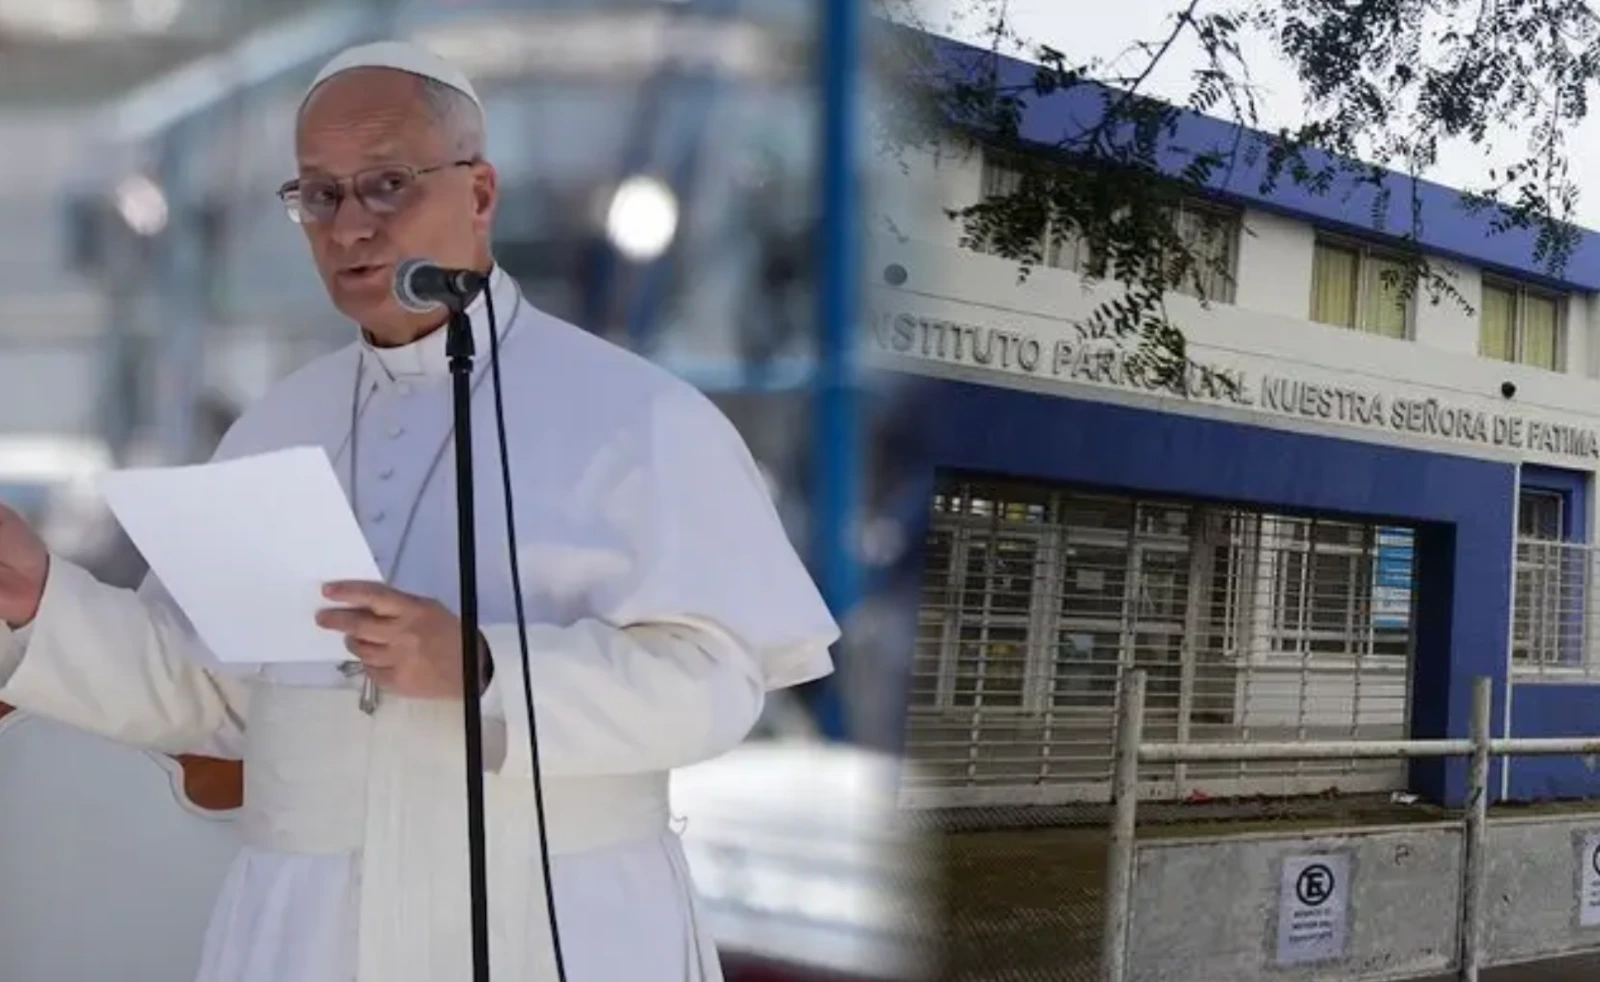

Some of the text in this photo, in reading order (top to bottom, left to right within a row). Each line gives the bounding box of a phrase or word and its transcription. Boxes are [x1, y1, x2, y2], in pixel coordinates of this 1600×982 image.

[868, 310, 1041, 372] NSTITUTO
[1260, 374, 1386, 426] NUESTRA
[1390, 399, 1488, 443] SEÑORA
[1493, 414, 1523, 448] DE
[1526, 420, 1600, 459] FATIMA
